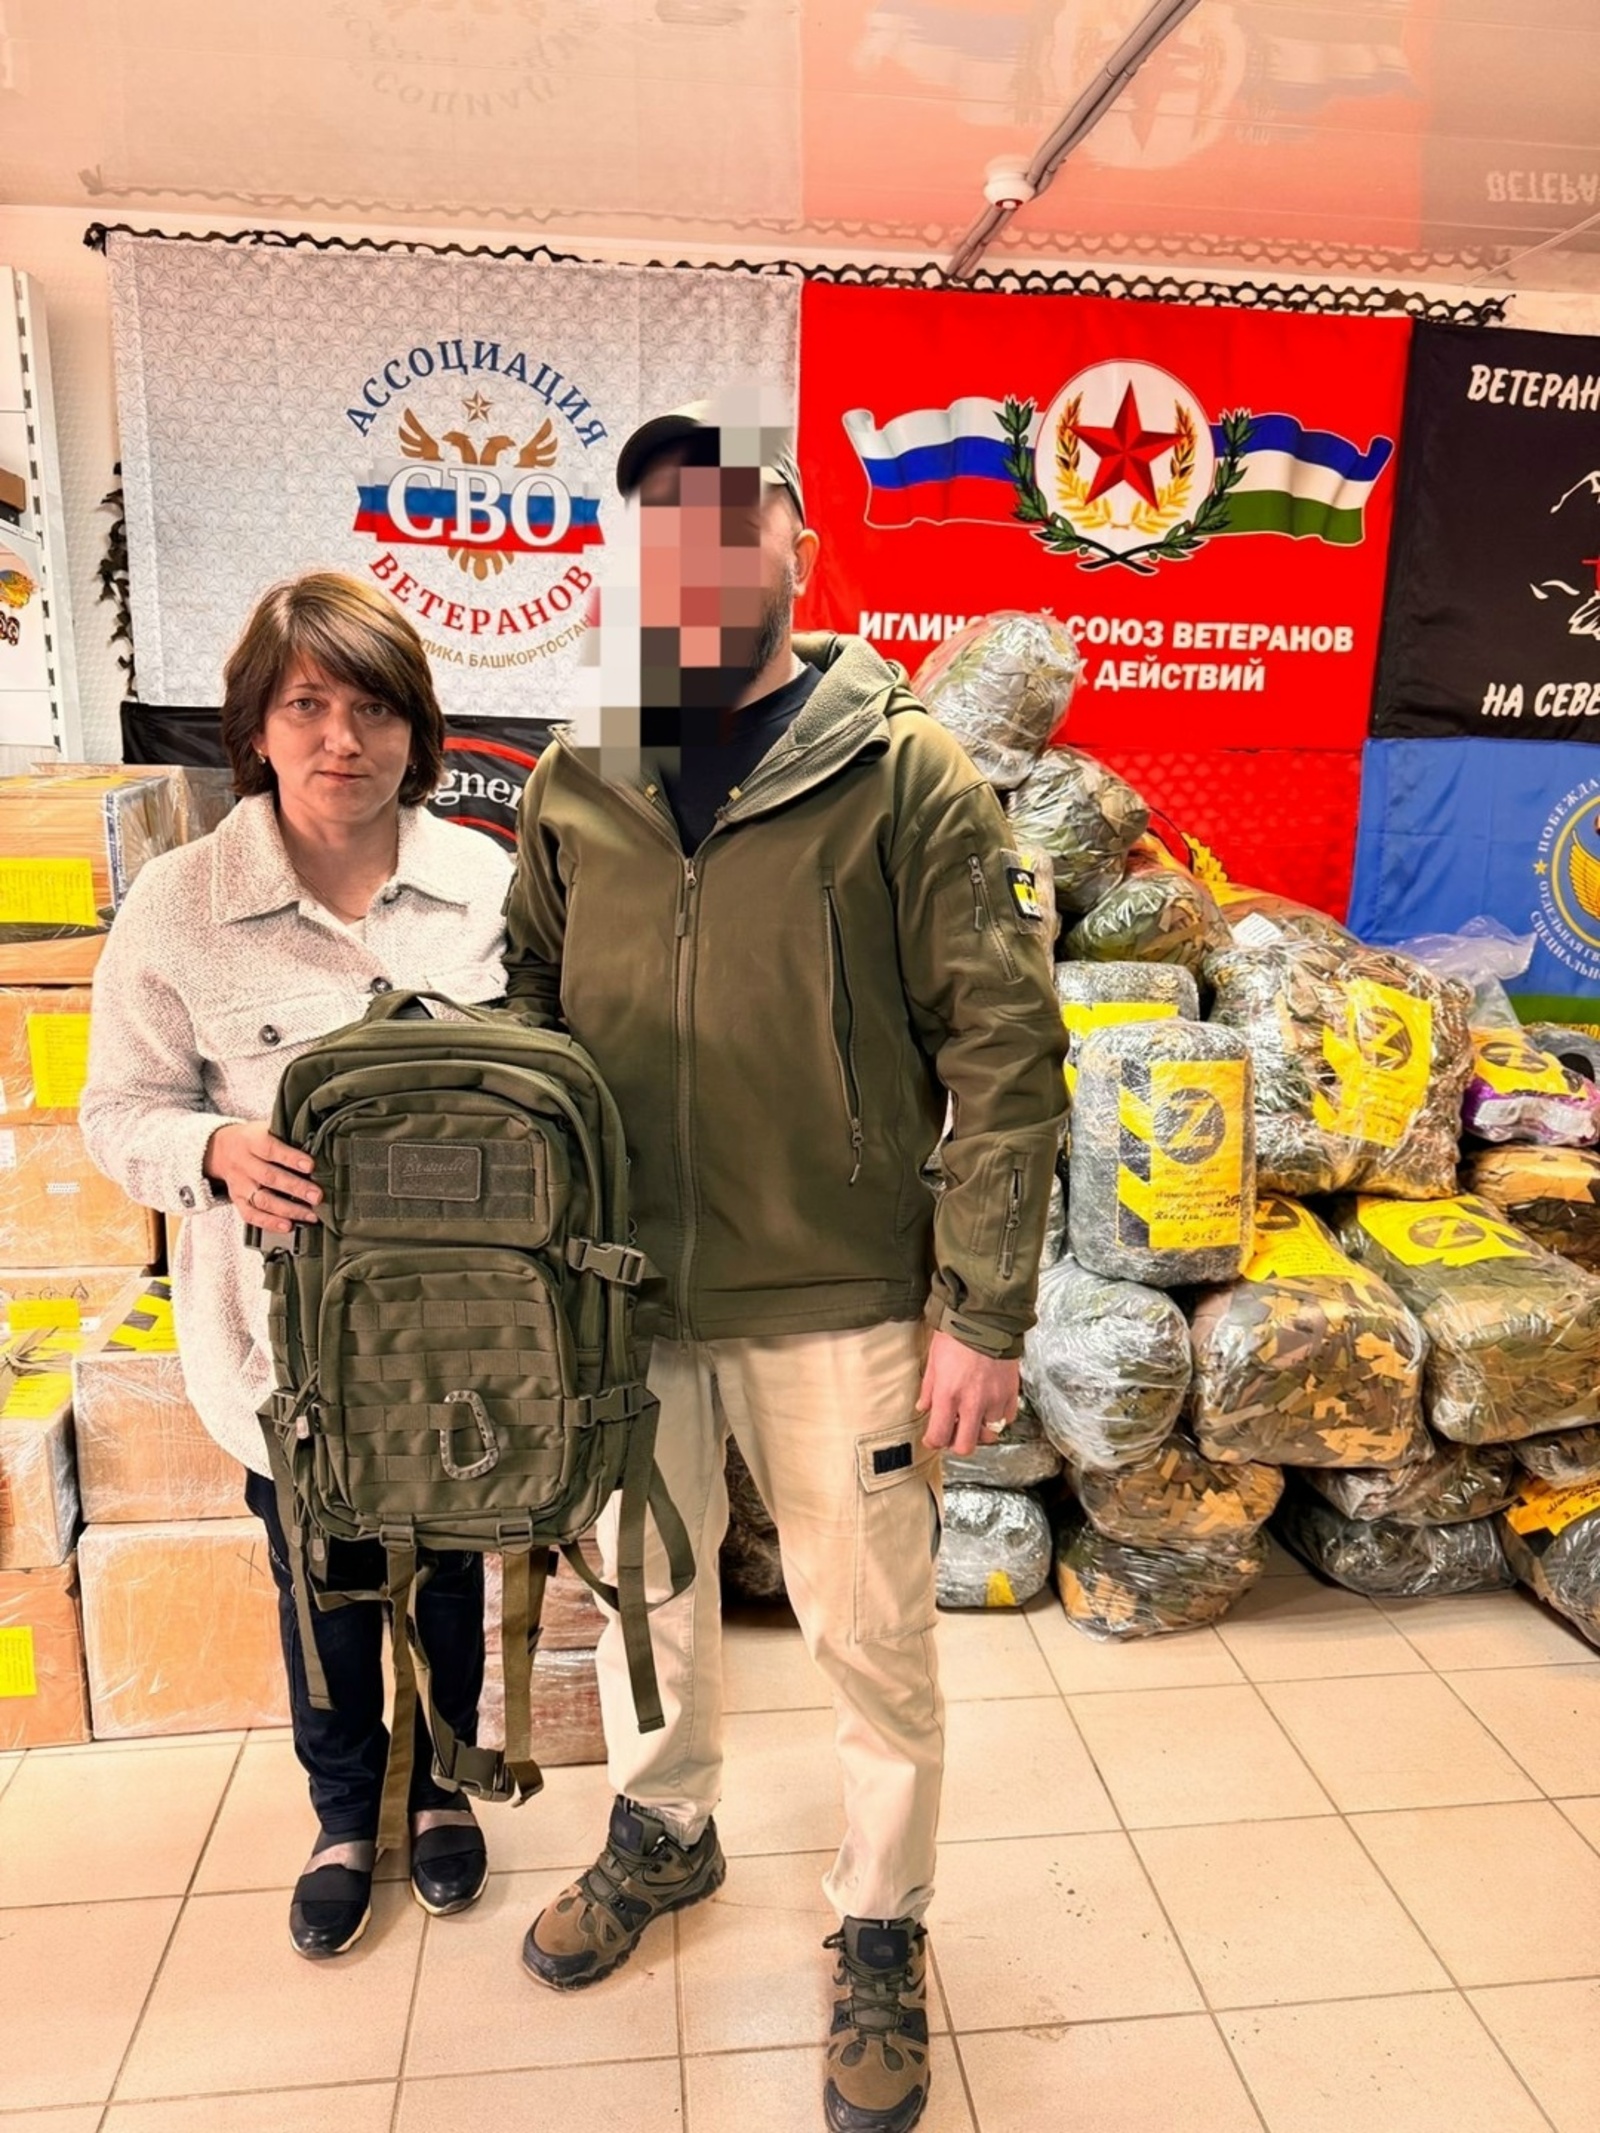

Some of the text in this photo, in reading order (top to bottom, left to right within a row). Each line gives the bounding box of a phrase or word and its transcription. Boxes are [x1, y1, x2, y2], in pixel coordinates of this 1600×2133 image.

[345, 339, 609, 450] АССОЦИАЦИЯ
[1467, 364, 1600, 412] ВЕТЕРАН
[387, 465, 572, 547] СВО
[369, 552, 594, 636] ВЕТЕРАНОВ
[1066, 615, 1164, 648] СОЮЗ
[1172, 621, 1354, 653] ВЕТЕРАНОВ
[1093, 655, 1266, 693] ДЕЙСТВИЙ
[1481, 682, 1524, 718] НА
